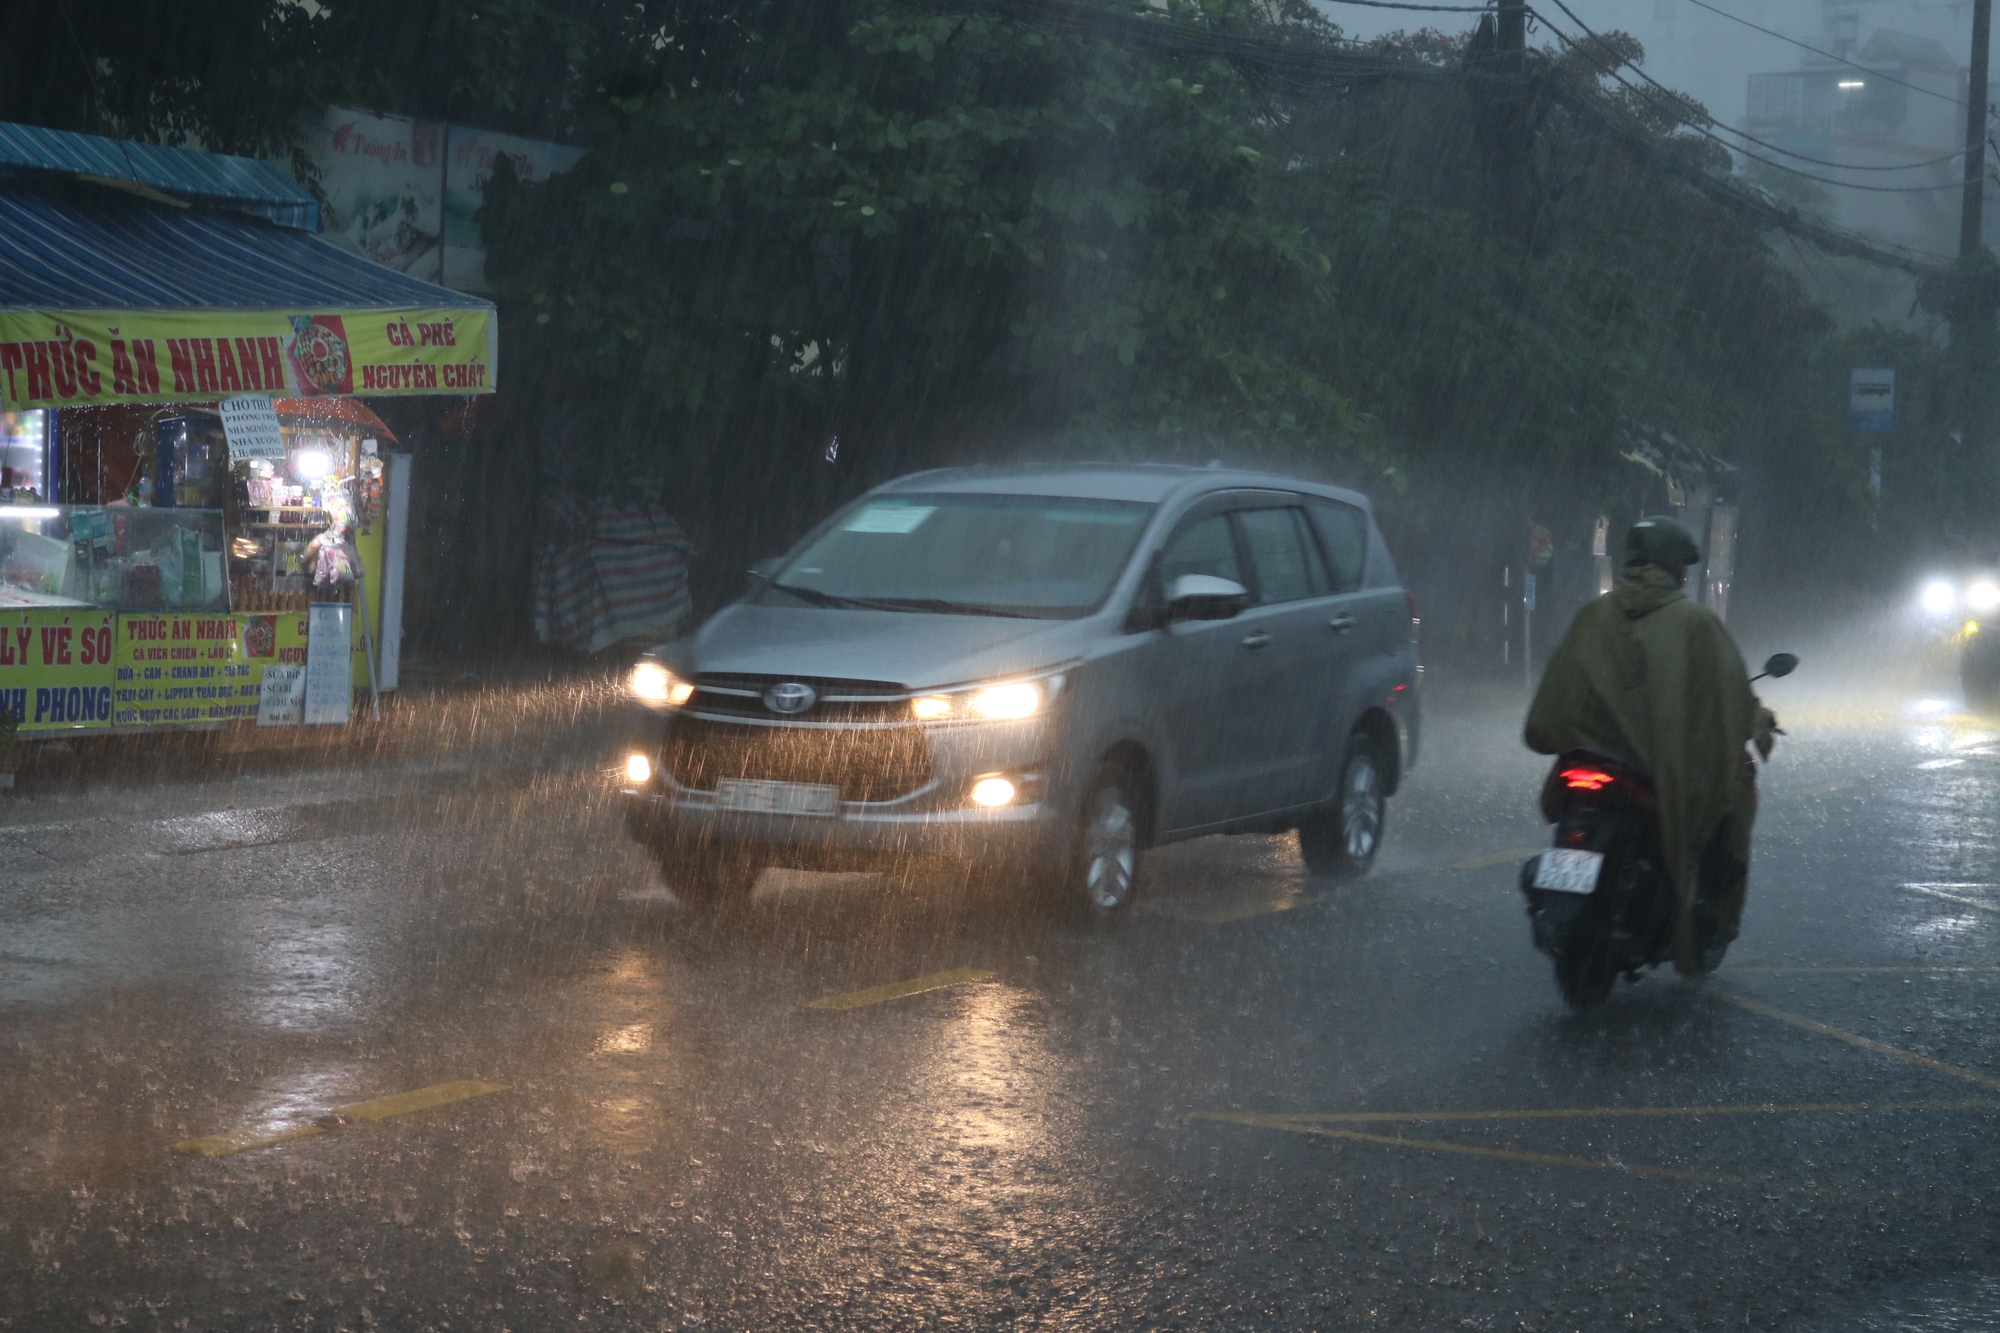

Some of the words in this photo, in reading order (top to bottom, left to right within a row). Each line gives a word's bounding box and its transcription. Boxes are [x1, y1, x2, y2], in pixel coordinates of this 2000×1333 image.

[386, 316, 415, 347] CÀ
[416, 316, 456, 347] PHÊ
[1, 324, 102, 402] THỨC
[108, 327, 160, 394] ĂN
[166, 336, 285, 393] NHANH
[362, 358, 438, 389] NGUYÊN
[442, 355, 486, 388] CHẤT
[221, 399, 250, 413] CHO
[251, 395, 274, 411] THUÊ
[225, 412, 260, 423] PHÒNG
[227, 424, 245, 435] NHÀ
[231, 435, 253, 447] NHÀ
[127, 615, 167, 640] THỨC
[171, 616, 191, 640] ĂN
[0, 616, 33, 666] LÝ
[40, 616, 73, 665] VÉ
[80, 612, 114, 665] SỐ
[148, 644, 168, 661] VIÊN
[278, 648, 307, 663] NGUY
[144, 667, 162, 680] CAM
[171, 666, 198, 679] CHANH
[165, 686, 194, 700] LIPTON
[34, 686, 111, 723] PHONG
